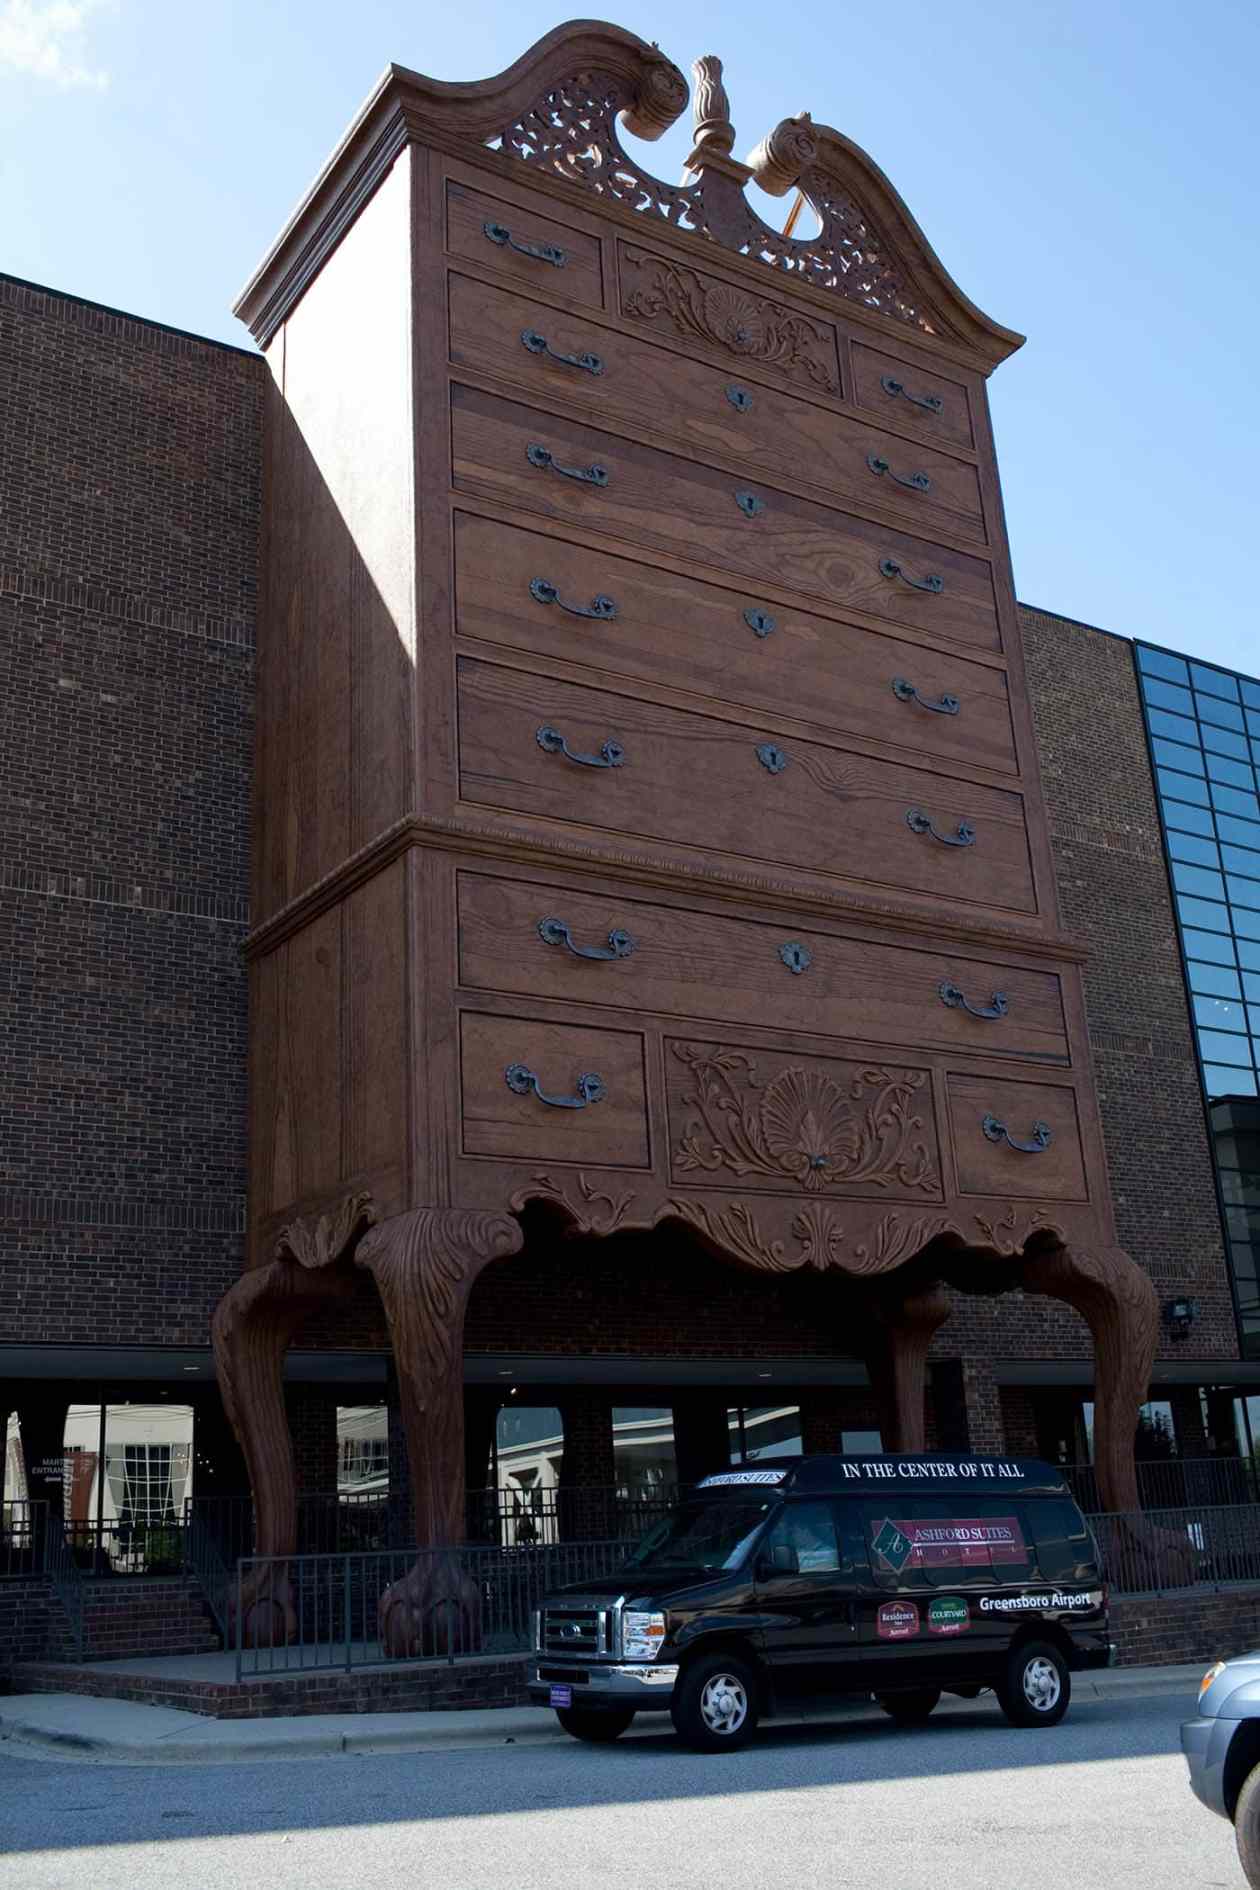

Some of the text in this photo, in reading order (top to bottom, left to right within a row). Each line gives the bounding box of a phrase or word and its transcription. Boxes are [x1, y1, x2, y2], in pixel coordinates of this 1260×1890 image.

[841, 1463, 1025, 1477] IN THE CENTER OF IT ALL
[915, 1527, 1012, 1541] ASHFORD SUITES
[980, 1592, 1091, 1610] Greensboro Airport
[932, 1609, 967, 1619] COURTYARD
